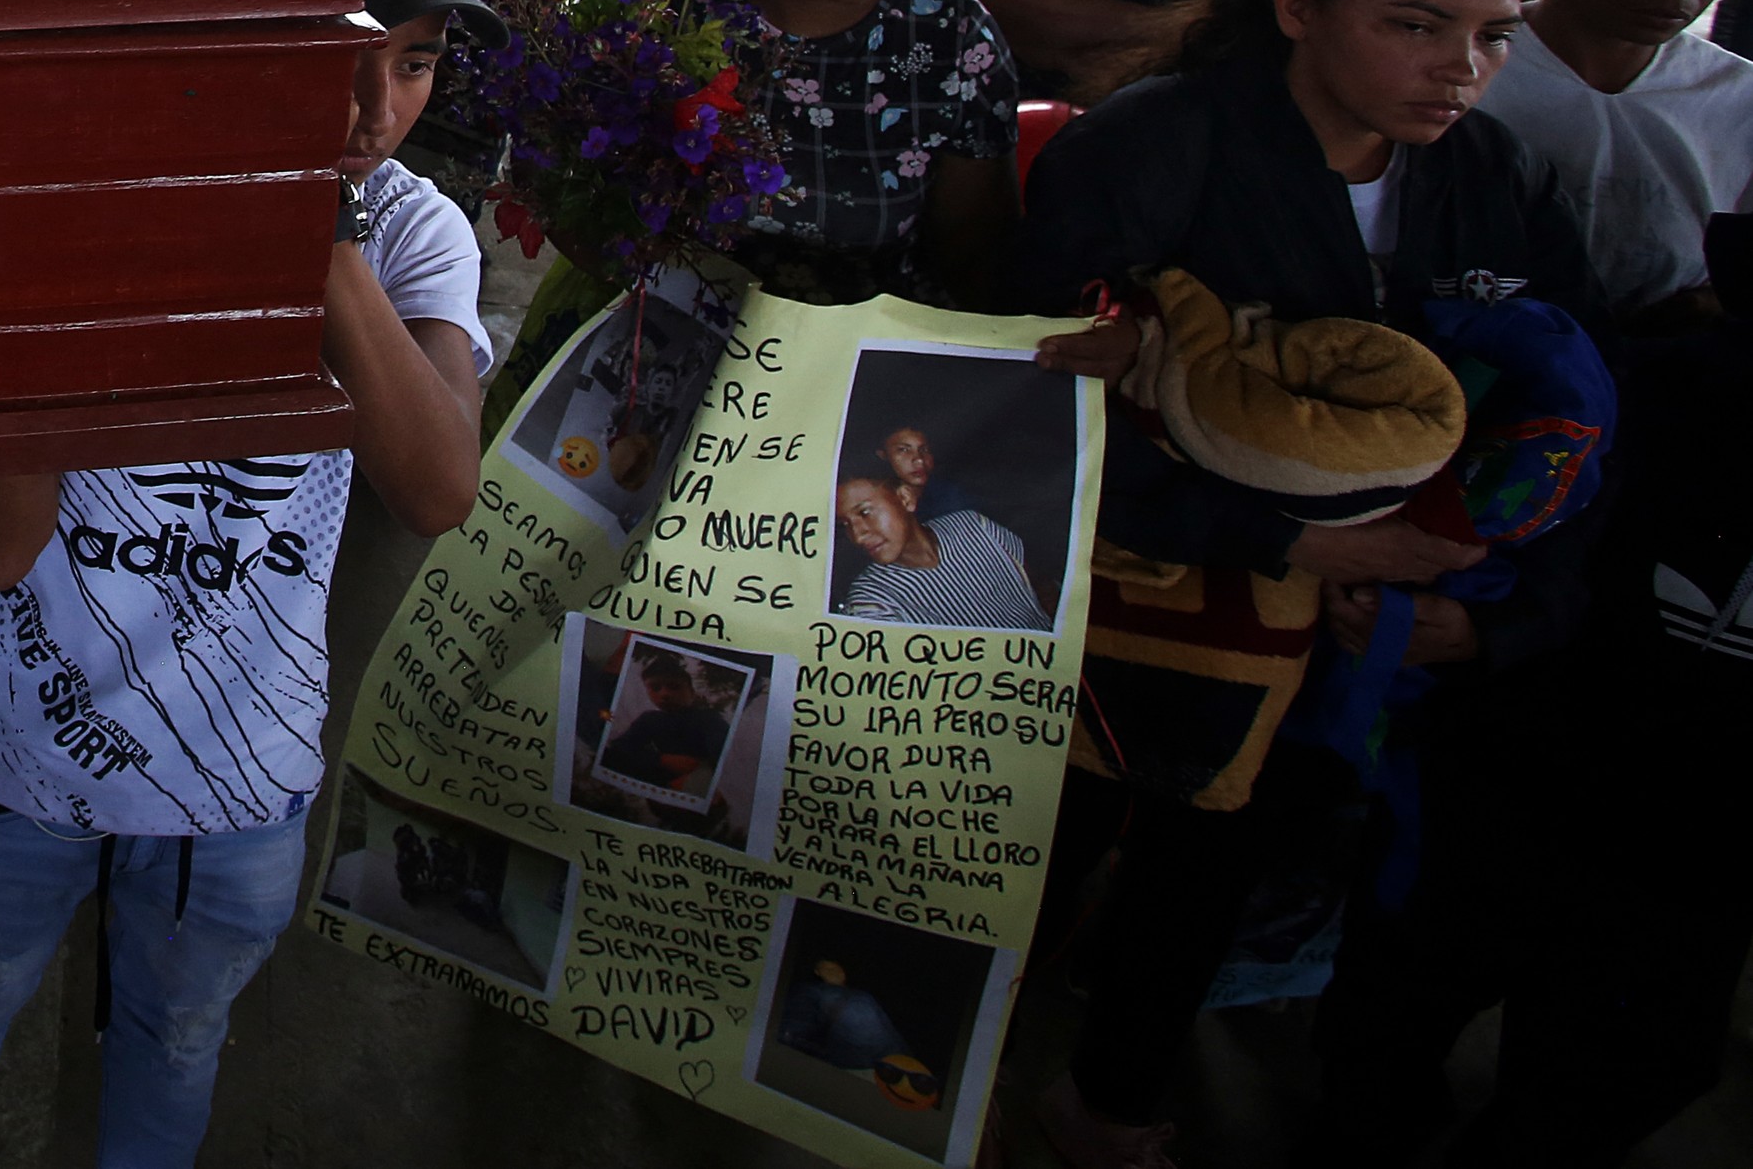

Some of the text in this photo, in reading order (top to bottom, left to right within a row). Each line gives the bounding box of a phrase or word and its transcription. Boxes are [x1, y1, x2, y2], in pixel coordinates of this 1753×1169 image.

[752, 434, 806, 462] SE
[670, 463, 713, 506] VA
[702, 509, 819, 558] MUERE
[621, 540, 794, 609] QUIEN SE
[489, 590, 527, 623] DE
[809, 622, 1056, 669] POR QUE UN
[394, 643, 546, 760] ARREBATAR
[796, 666, 1077, 718] MOMENTO SERA
[38, 672, 132, 781] SPORT
[103, 719, 153, 768] SYSTEM
[380, 681, 548, 792] NUESTROS
[793, 699, 1066, 747] SU IRA PERO SU
[788, 734, 992, 774] FAVOR DURA
[782, 788, 1000, 834] POR LA NOCHE
[784, 767, 1013, 807] TODA LA VIDA
[585, 829, 793, 891] TE ARREBATARON
[778, 807, 1042, 867] DURARA EL LLORO
[580, 850, 770, 910] LA VIDA PERO
[774, 846, 927, 900] VENDRA LA
[805, 835, 822, 852] A
[831, 839, 868, 867] LA
[877, 853, 1005, 892] MAÑANA
[583, 879, 771, 932] EN NUESTROS
[583, 907, 763, 961] CORAZONES
[313, 909, 550, 1027] TE EXTRAÑAMOS
[596, 966, 720, 1001] VIVIRAS
[571, 1004, 715, 1051] DAVID
